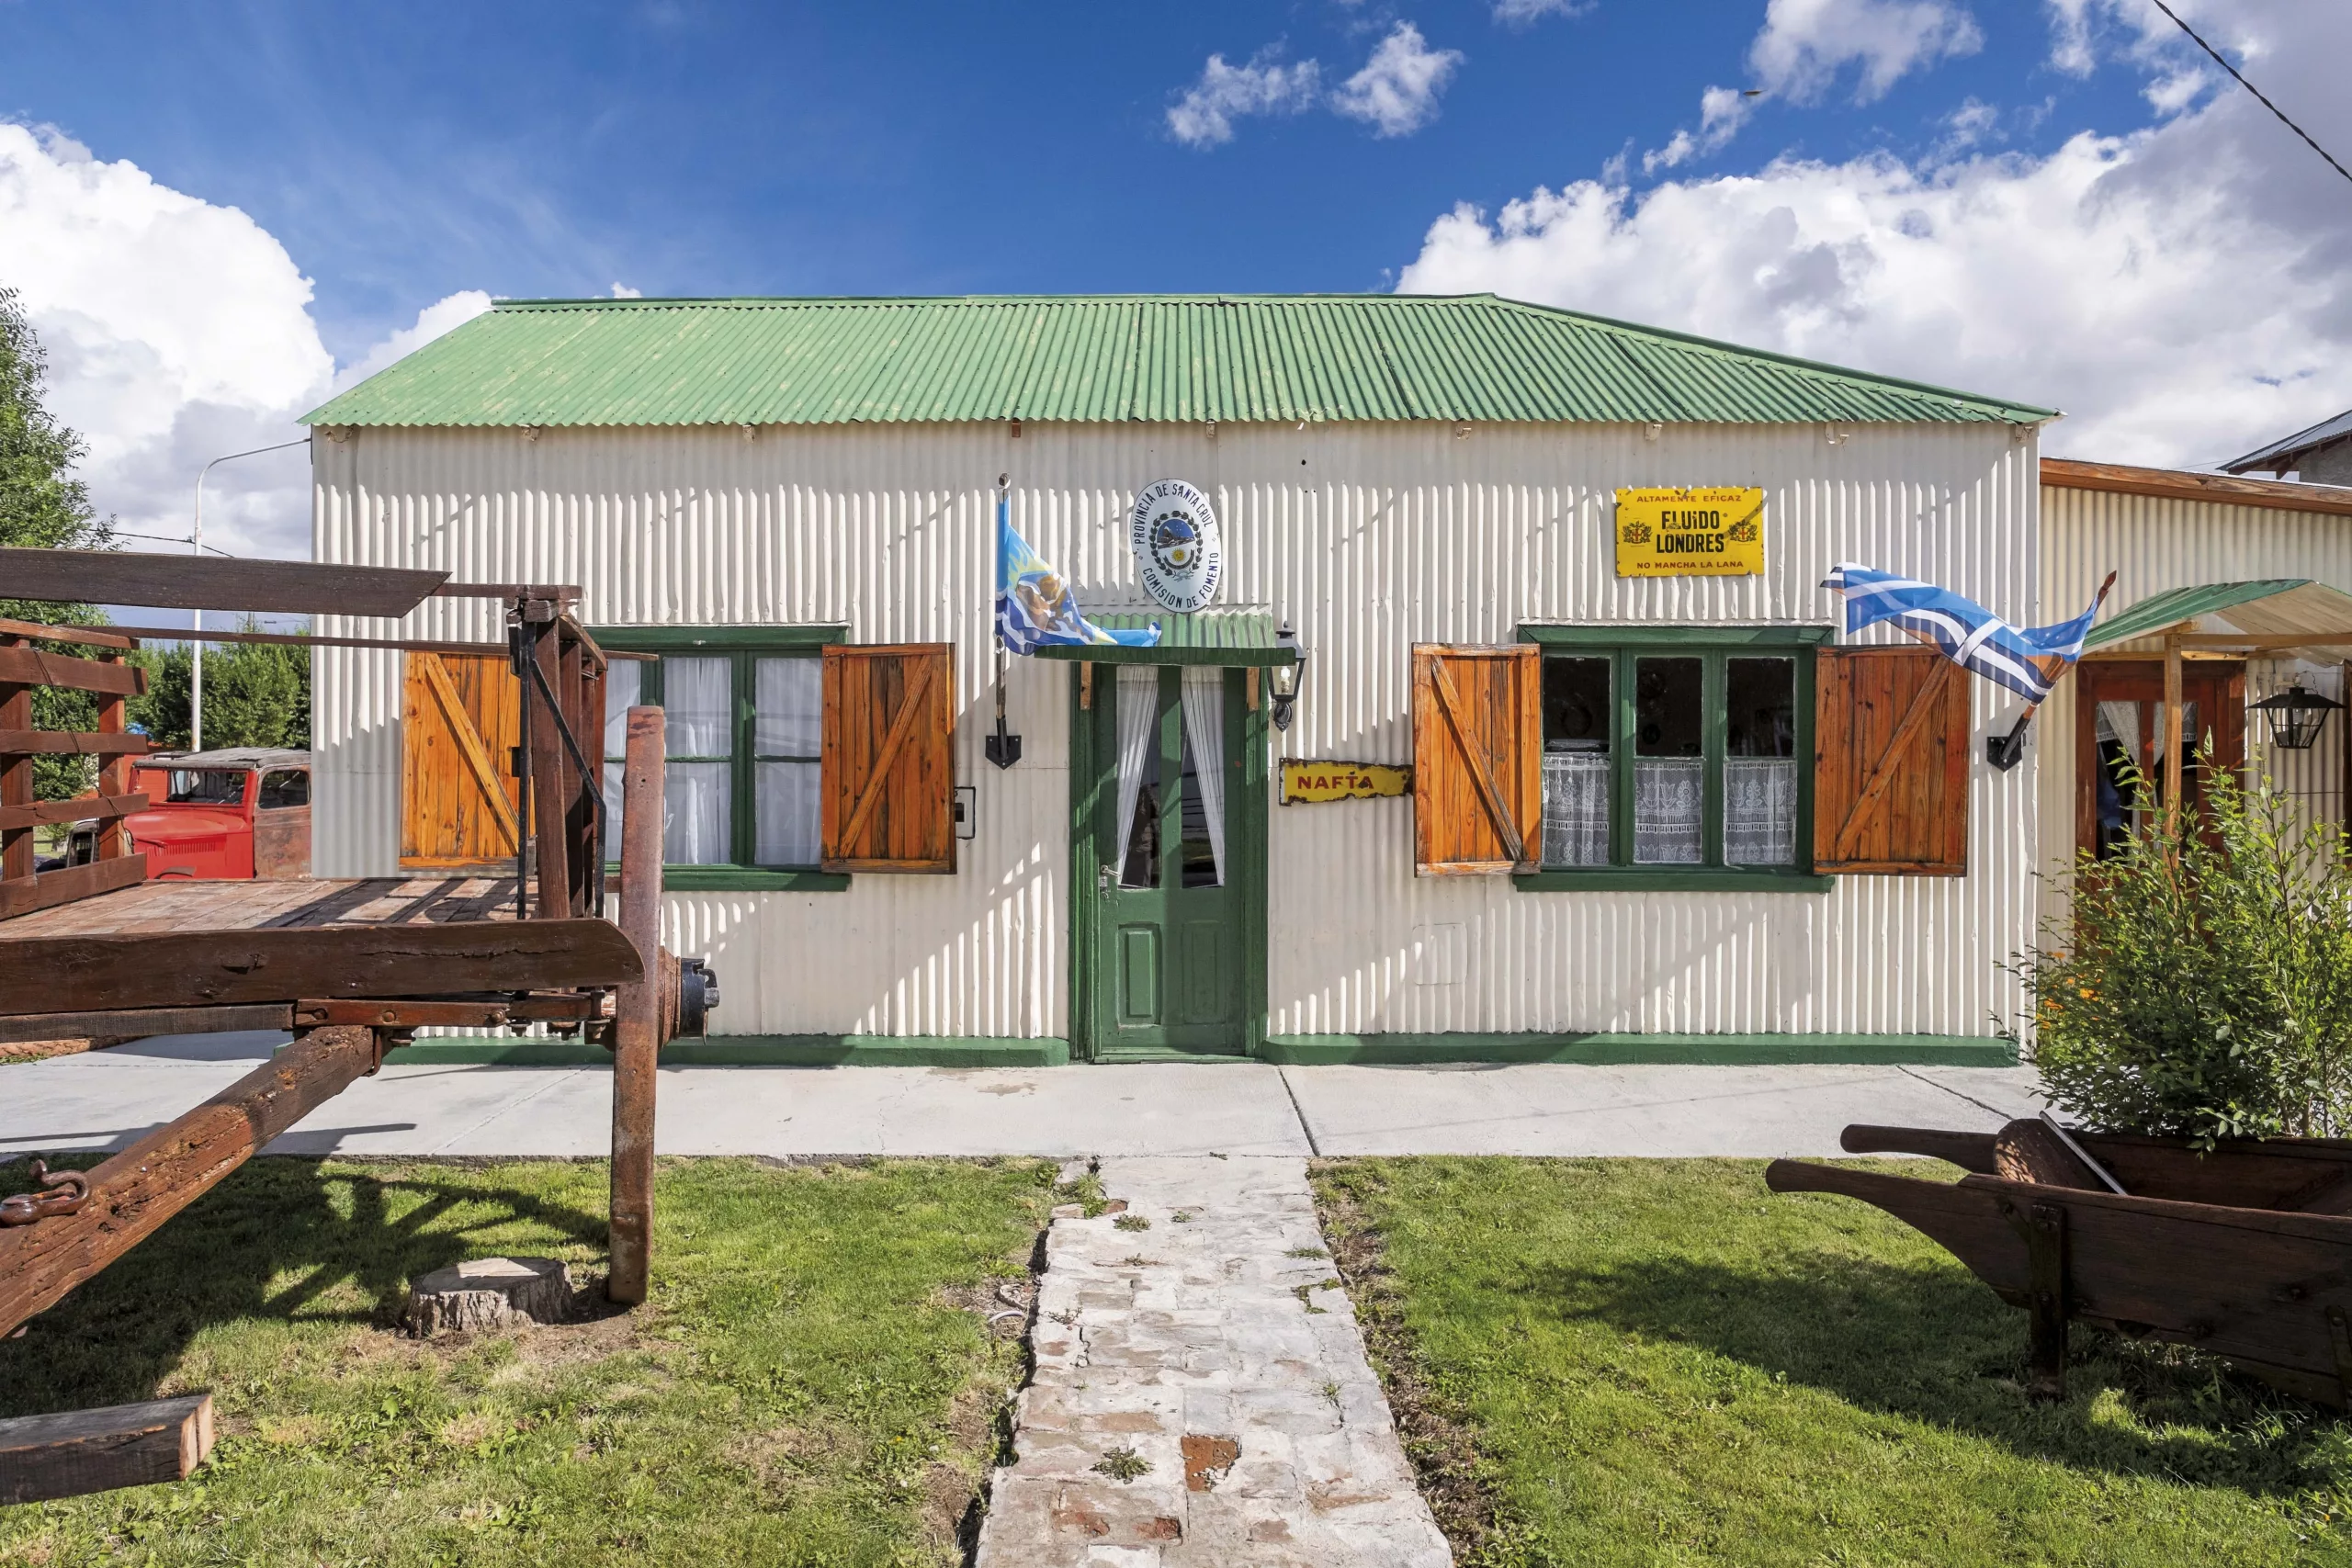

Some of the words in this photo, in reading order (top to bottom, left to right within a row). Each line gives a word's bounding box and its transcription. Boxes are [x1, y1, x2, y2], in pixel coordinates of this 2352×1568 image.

[1134, 491, 1156, 544] PROVINCIA
[1156, 483, 1169, 498] DE
[1172, 483, 1199, 508] SANTA
[1196, 503, 1214, 528] CRUZ
[1656, 533, 1724, 554] LONDRES
[1142, 567, 1182, 609] COMISION
[1187, 597, 1199, 609] DE
[1199, 552, 1219, 600] FOMENTO
[1297, 775, 1374, 790] NAFTA
